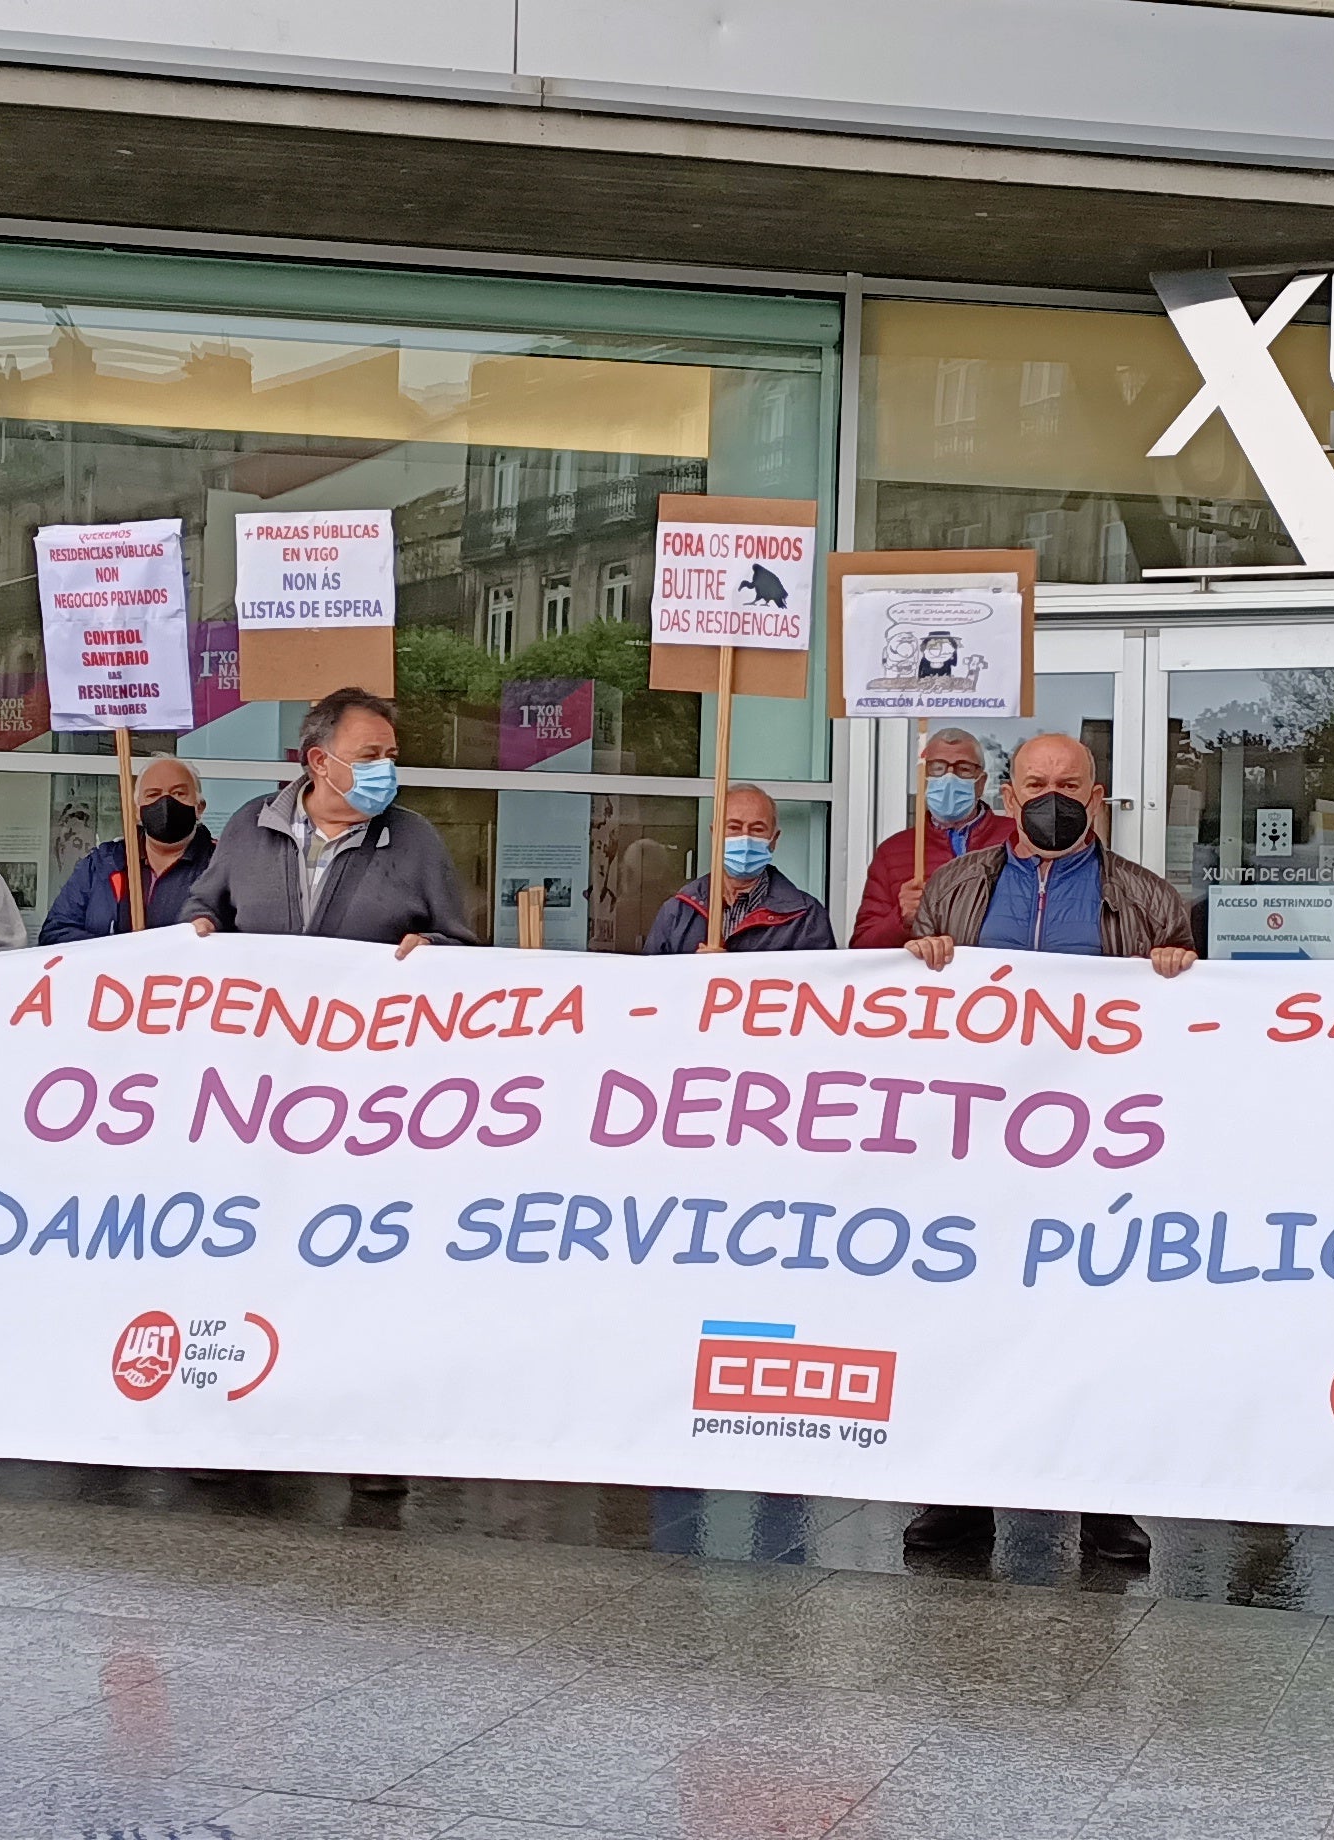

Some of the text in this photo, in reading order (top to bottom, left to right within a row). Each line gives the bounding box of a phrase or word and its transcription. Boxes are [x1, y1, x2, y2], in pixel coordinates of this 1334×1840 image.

[257, 525, 309, 540] PRAZAS
[313, 520, 379, 539] PÚBLICAS
[49, 541, 164, 562] RESIDENCIAS PÚBLICAS
[283, 547, 339, 562] EN VIGO
[663, 532, 803, 562] FORA OS FONDOS
[95, 567, 120, 583] NON
[283, 567, 341, 591] NON ÁS
[661, 568, 727, 601] BUITRE
[54, 588, 168, 609] NEGOCIOS PRIVADOS
[242, 599, 383, 619] LISTAS DE ESPERA
[659, 608, 801, 639] DAS RESIDENCIAS
[83, 629, 143, 646] CONTROL
[81, 650, 149, 667] SANITARIO
[218, 651, 238, 664] XO
[218, 663, 239, 677] NA
[78, 683, 160, 700] RESIDENCIAS
[856, 694, 914, 708] ATENCIÓN
[926, 697, 1006, 708] DEPENDENCIA
[94, 704, 107, 716] DE
[1202, 867, 1256, 882] XUNTA
[1260, 868, 1280, 882] DE
[1217, 898, 1258, 908] ACCESO
[1263, 898, 1333, 908] RESTRINXIDO
[1217, 934, 1251, 942] ENTRADA
[10, 955, 64, 1028] Á
[87, 973, 585, 1052] DEPENDENCIA
[698, 963, 1143, 1055] PENSIÓNS
[23, 1066, 1167, 1170] OS NOSOS DEREITOS
[297, 1200, 414, 1268] OS
[444, 1190, 978, 1284] SERVICIOS
[189, 1319, 227, 1337] UXP
[126, 1326, 175, 1361] UGT
[183, 1341, 246, 1363] Galicia
[180, 1366, 218, 1389] Vigo
[708, 1356, 880, 1404] CCOO
[692, 1415, 888, 1449] pensionistas vigo
